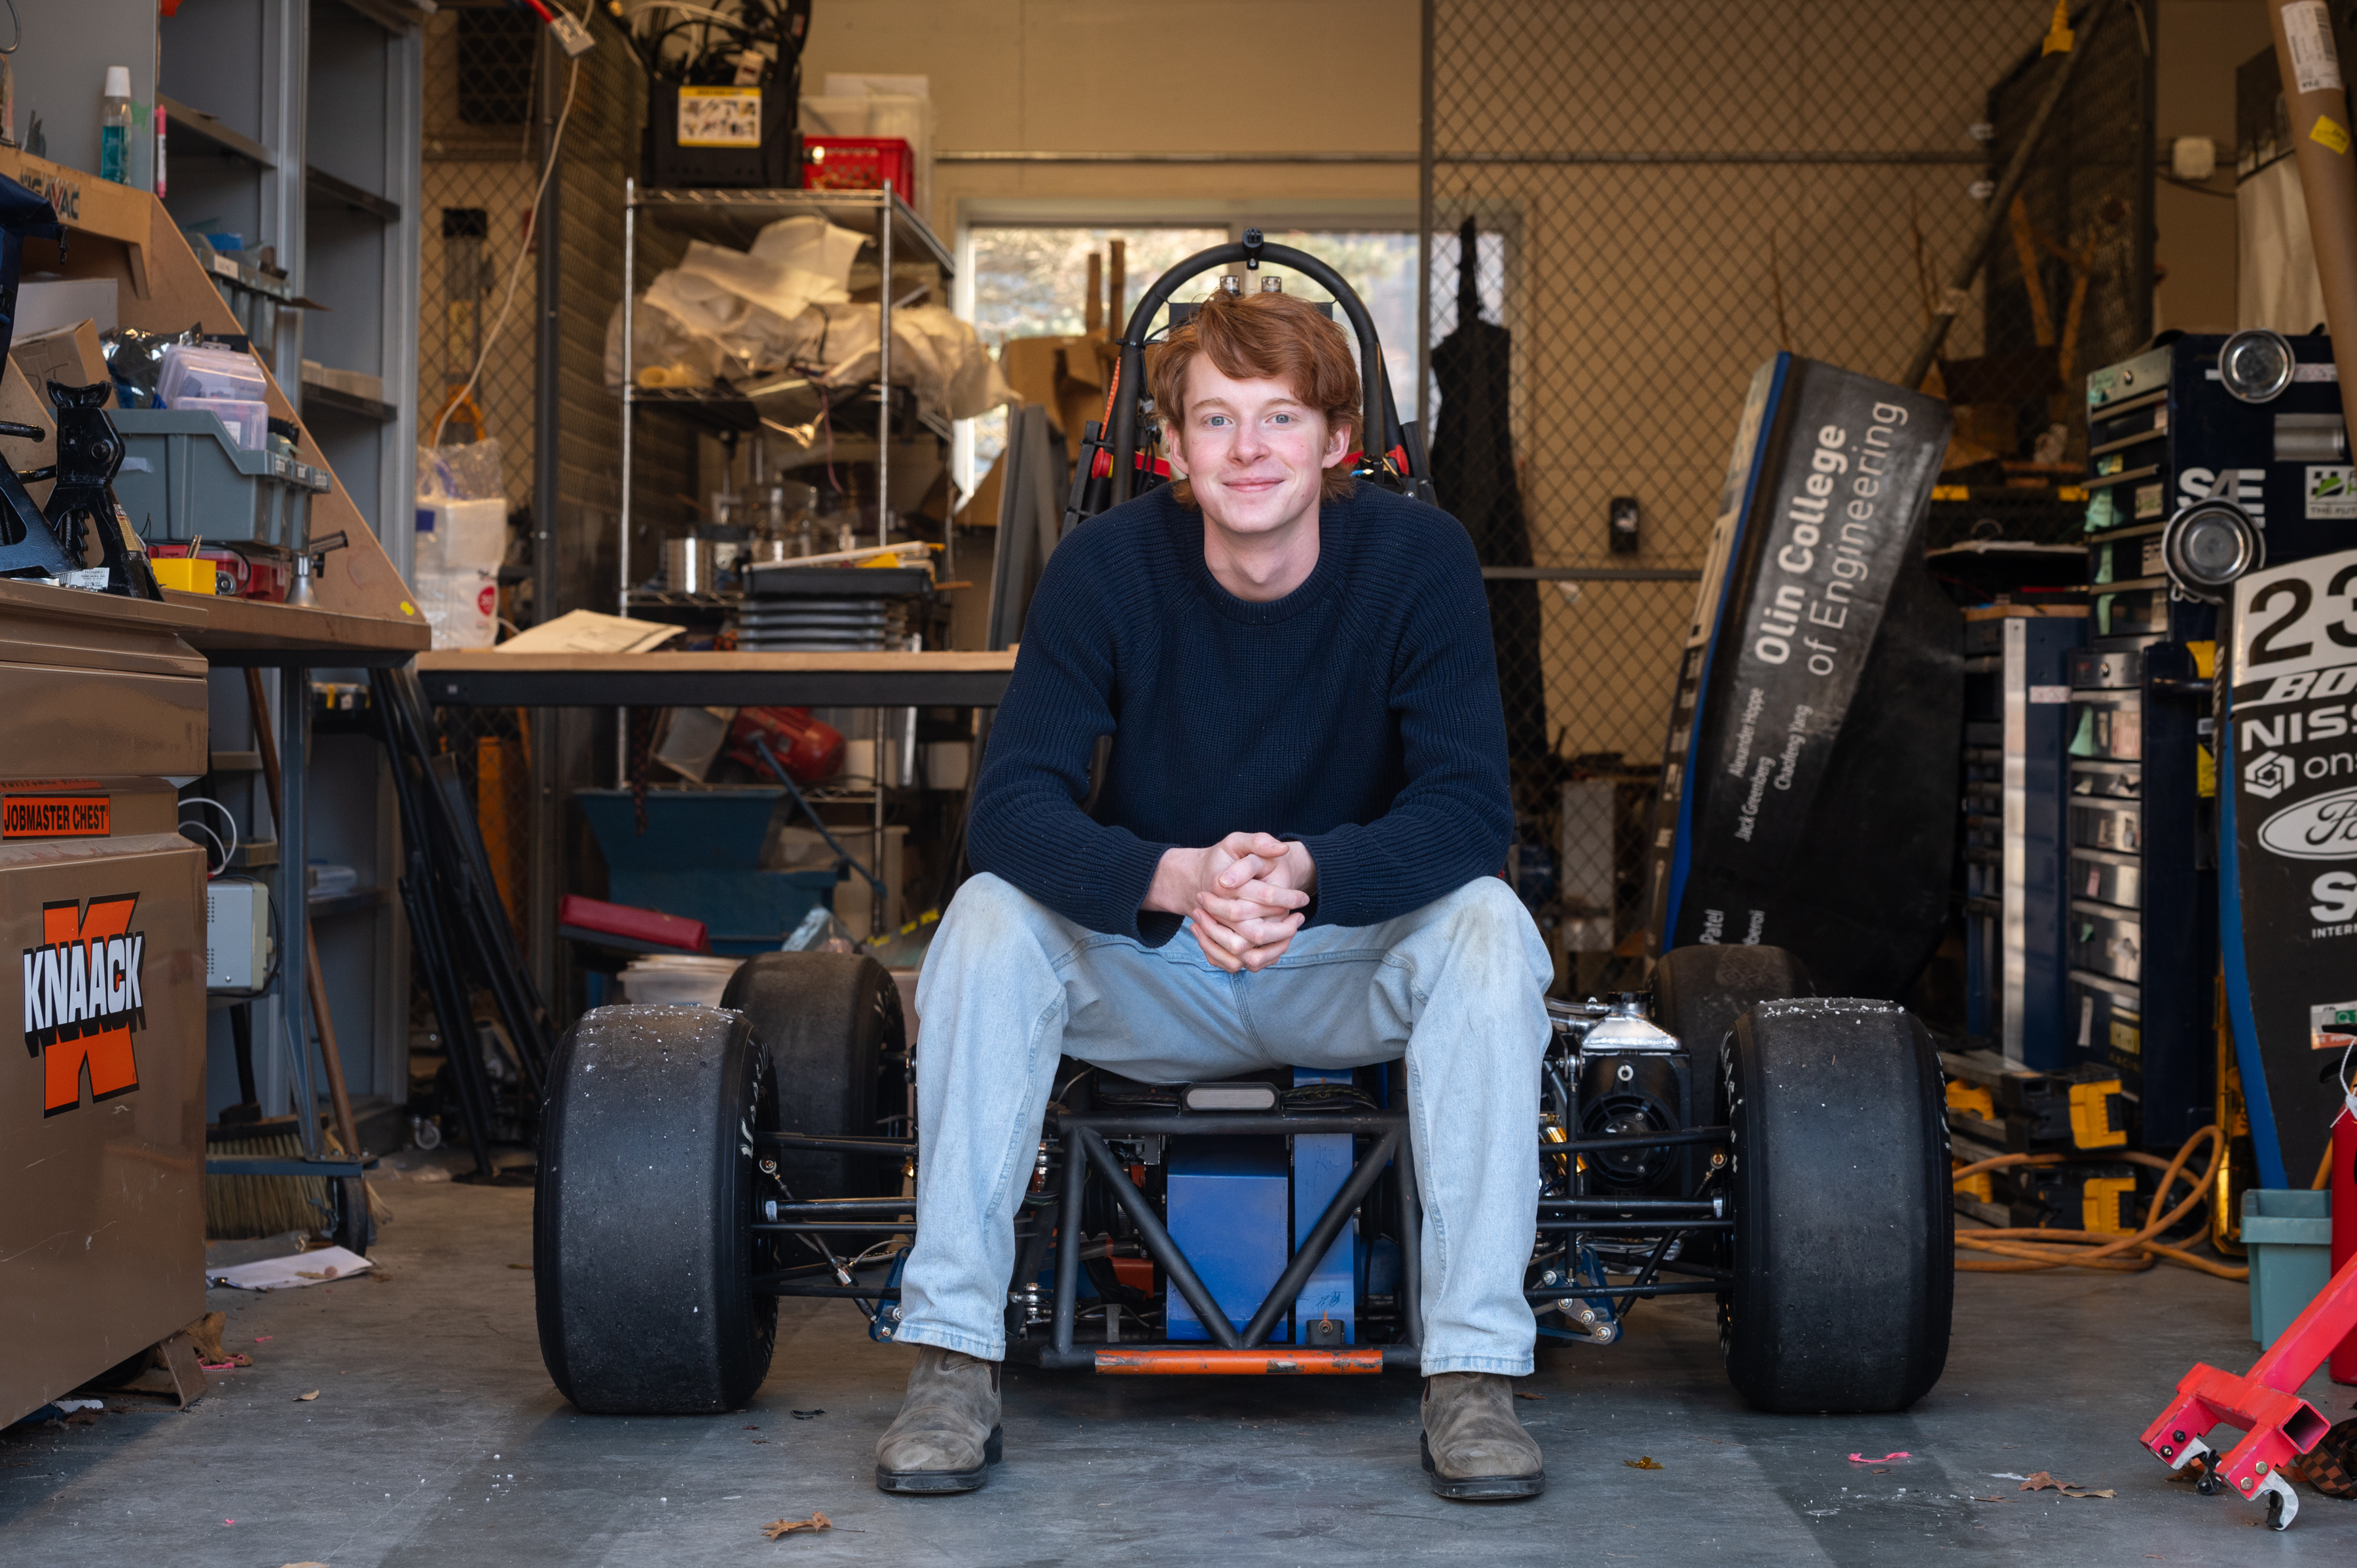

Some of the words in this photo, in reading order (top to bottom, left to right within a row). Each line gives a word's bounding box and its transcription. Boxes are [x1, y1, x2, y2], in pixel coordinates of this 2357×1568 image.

[1777, 424, 1848, 574] College
[1808, 401, 1909, 630] Engineering
[1755, 584, 1806, 665] Olin
[1803, 634, 1838, 676] of
[1741, 687, 1765, 725] Hoppe
[2261, 665, 2357, 702] BO
[1787, 703, 1814, 733] Yang
[2241, 703, 2357, 753] NIS
[1728, 724, 1755, 778] Alexander
[1773, 733, 1806, 790] Chaofeng
[2303, 752, 2357, 779] on
[1740, 756, 1777, 816] Greenberg
[4, 804, 70, 832] JOBMASTER
[73, 804, 106, 830] CHEST
[1734, 815, 1756, 843] Jack
[2310, 871, 2357, 922] S
[1698, 909, 1725, 945] Patel
[1742, 909, 1766, 946] beroi
[24, 936, 142, 1033] KNAACK
